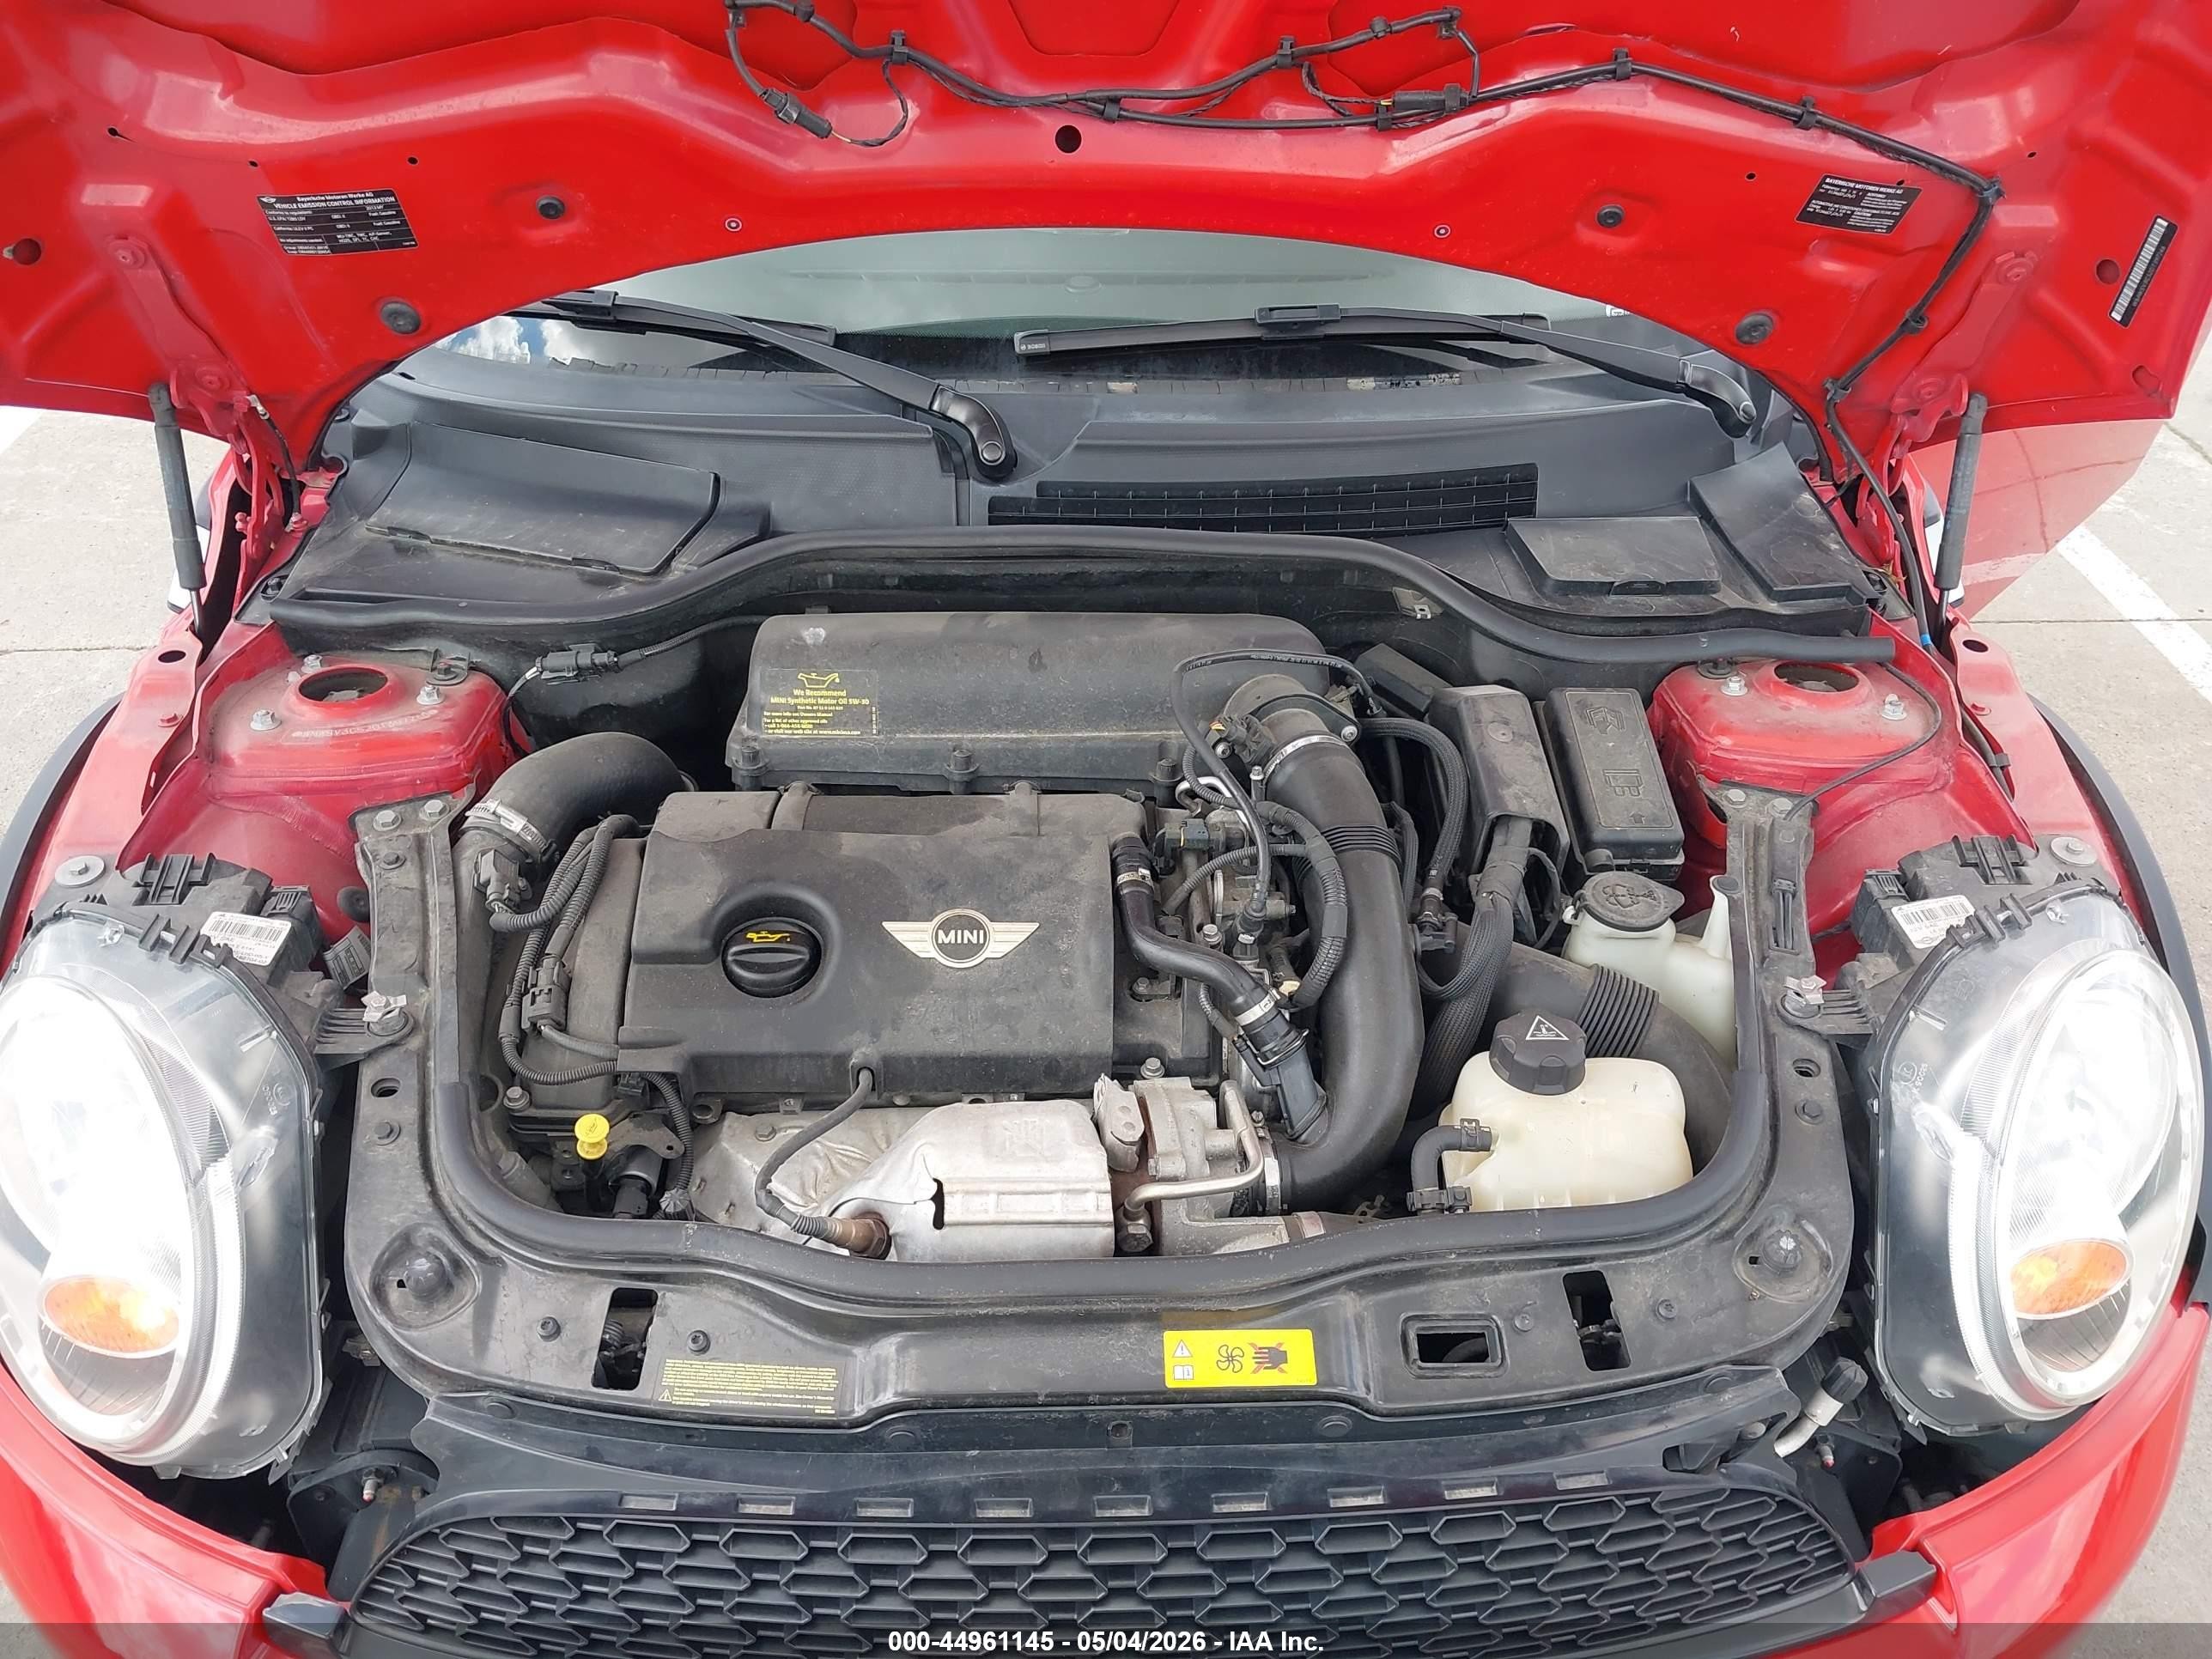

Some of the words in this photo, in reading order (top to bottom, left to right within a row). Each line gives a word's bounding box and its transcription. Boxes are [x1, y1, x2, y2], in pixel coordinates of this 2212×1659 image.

[355, 197, 396, 205] INFORMATION
[787, 696, 817, 705] Synthetic
[938, 930, 984, 944] MINI
